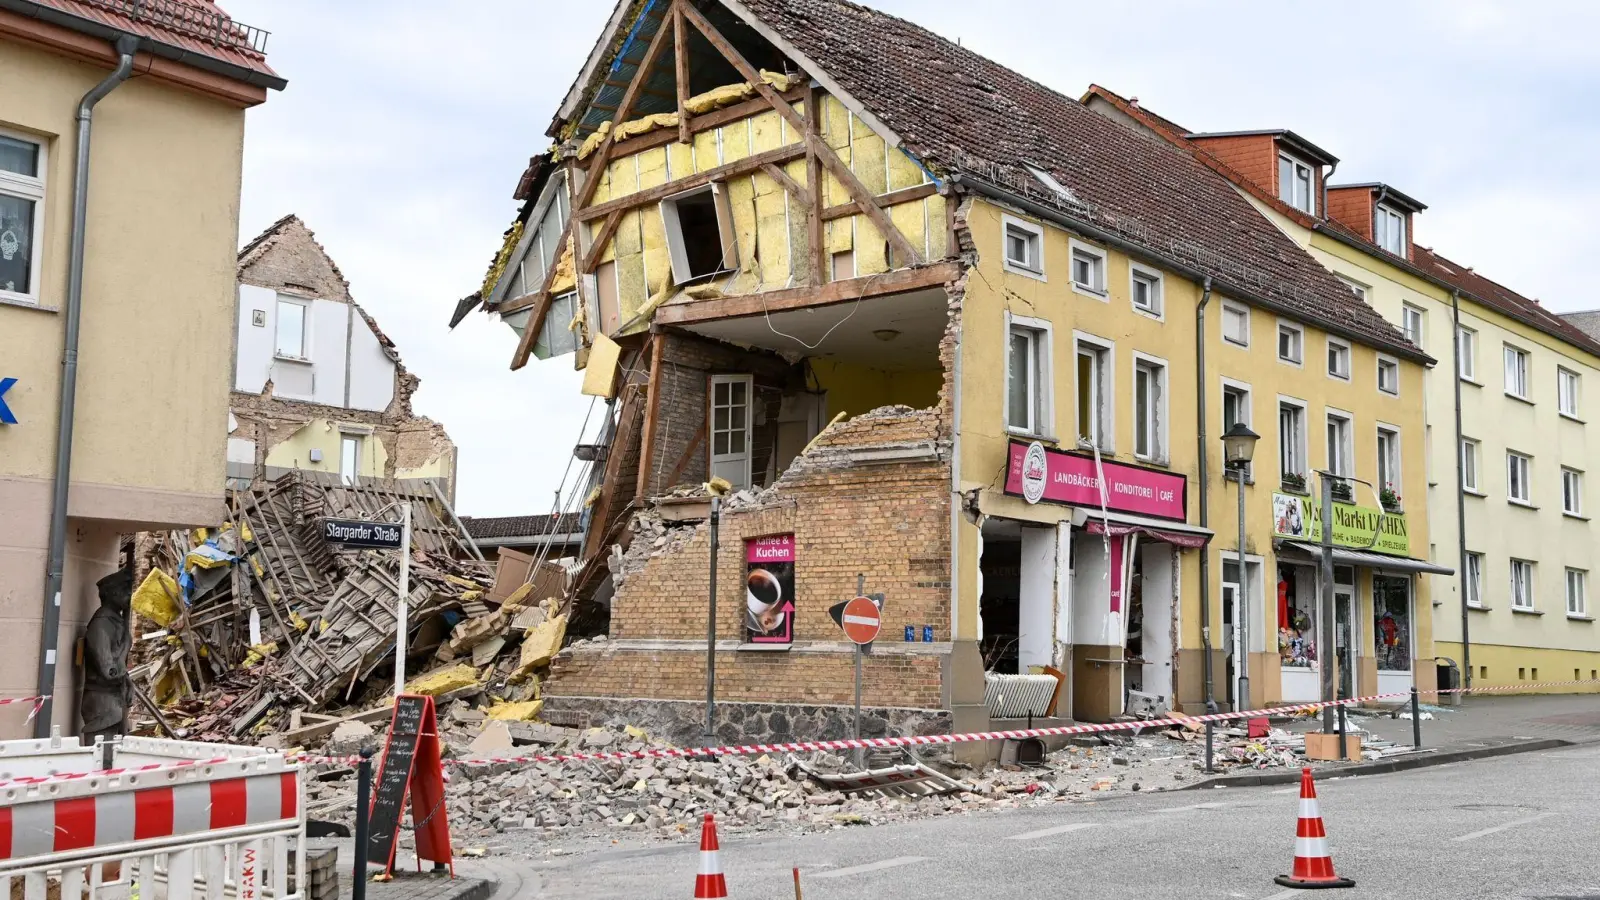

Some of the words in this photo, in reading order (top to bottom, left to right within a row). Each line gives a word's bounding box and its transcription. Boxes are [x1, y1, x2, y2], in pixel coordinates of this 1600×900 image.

[1114, 481, 1153, 499] KONDITOREI
[1160, 489, 1174, 502] CAFÉ
[1334, 506, 1366, 530] Markt
[326, 522, 372, 541] Stargarder
[374, 526, 399, 542] Straße
[756, 546, 789, 558] Kuchen
